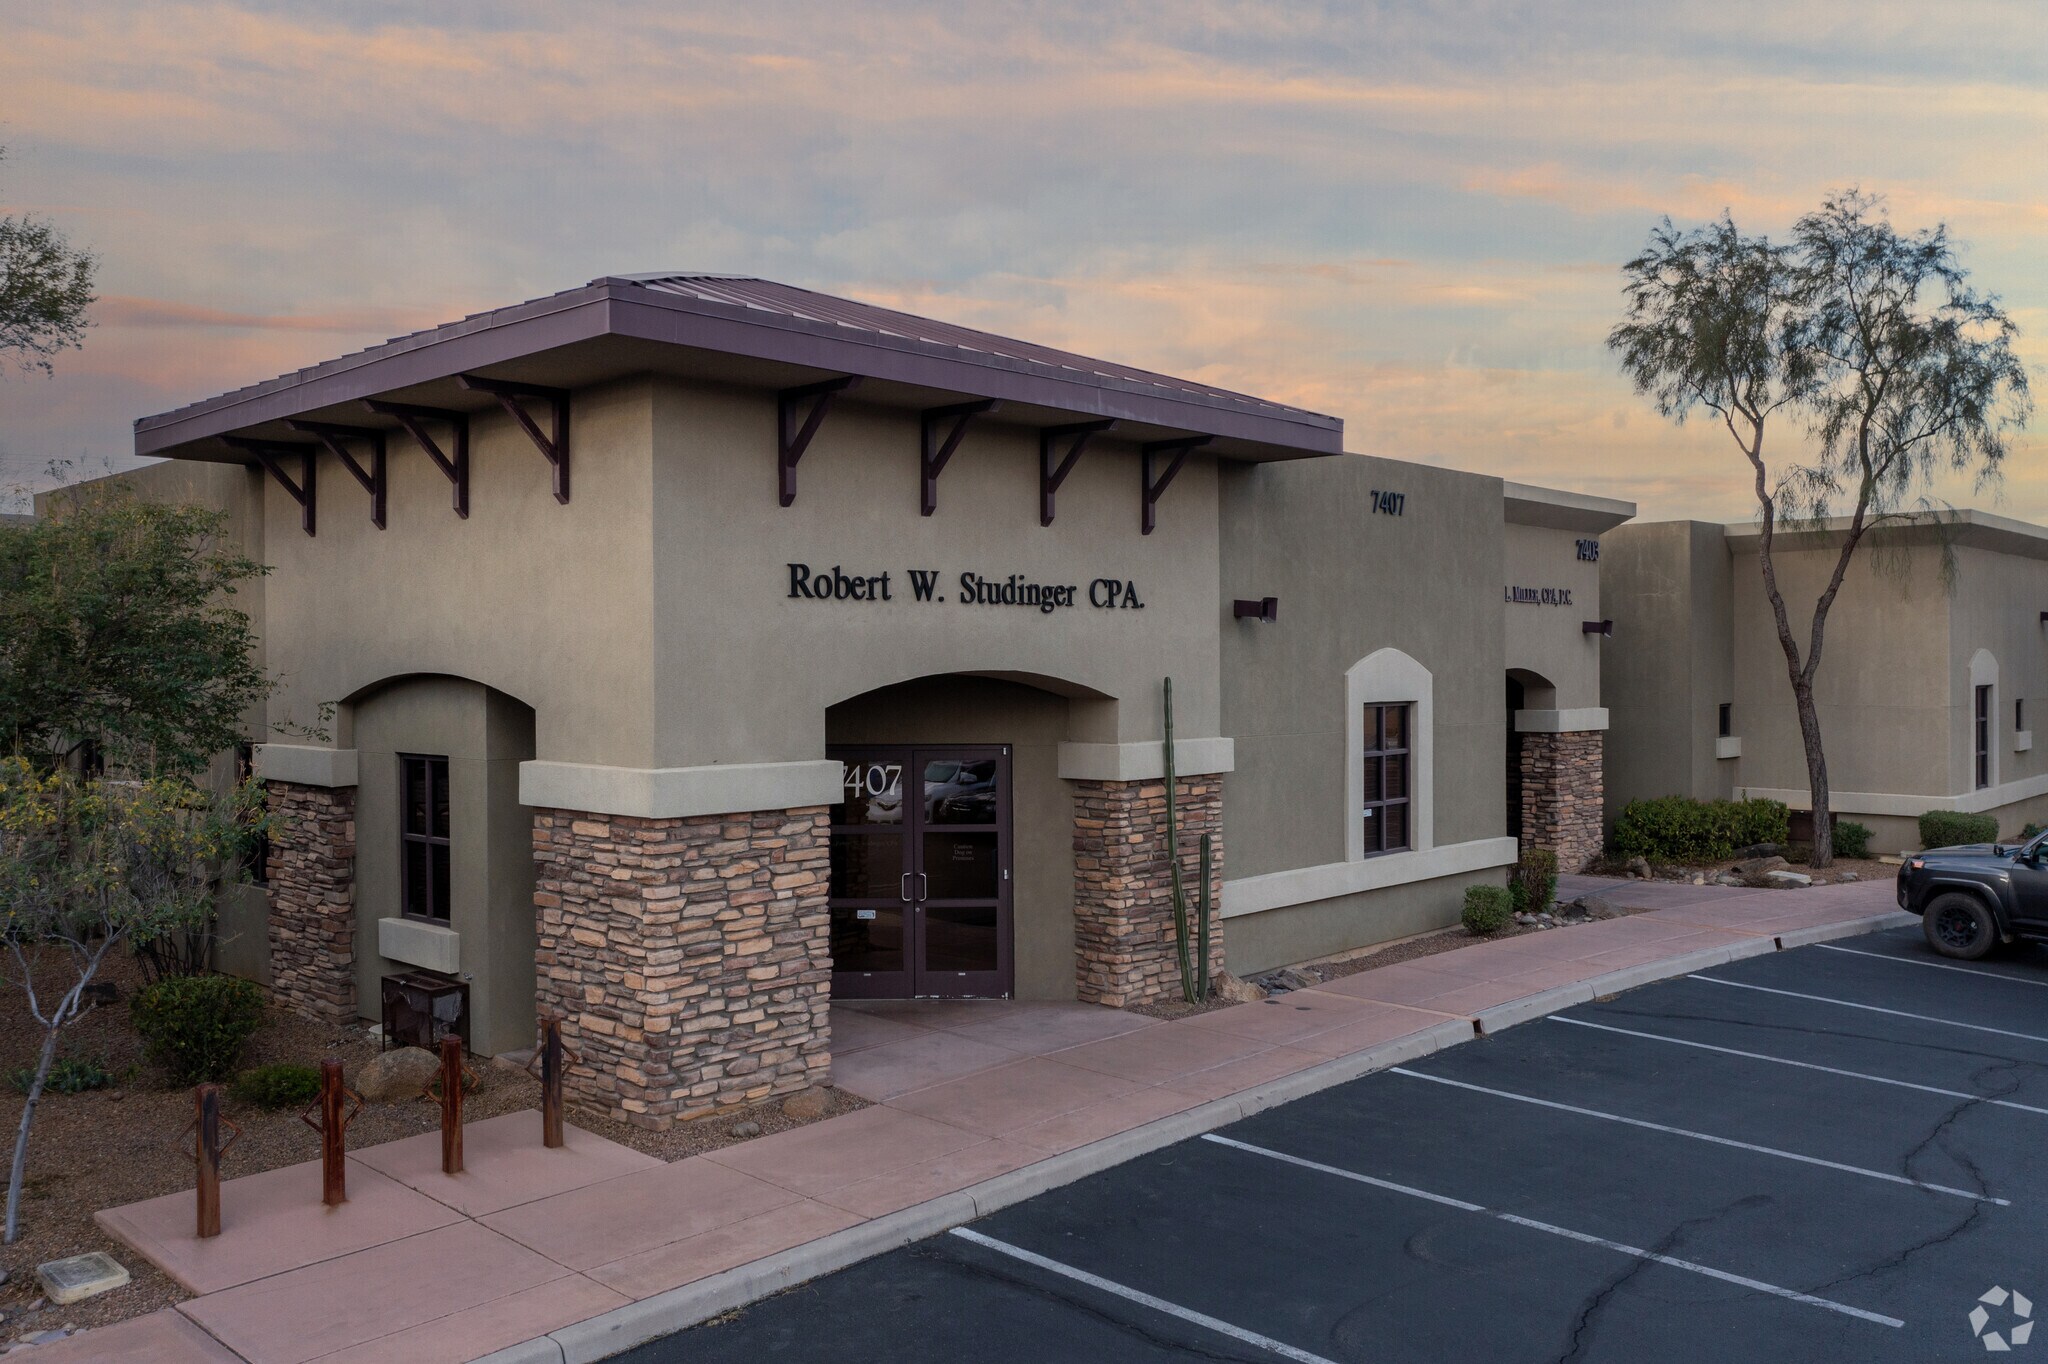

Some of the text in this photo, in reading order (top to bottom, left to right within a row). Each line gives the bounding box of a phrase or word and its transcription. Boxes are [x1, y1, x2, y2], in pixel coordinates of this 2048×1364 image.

[1370, 490, 1405, 516] 7407
[786, 563, 1145, 613] Robert W. Studinger CPA.
